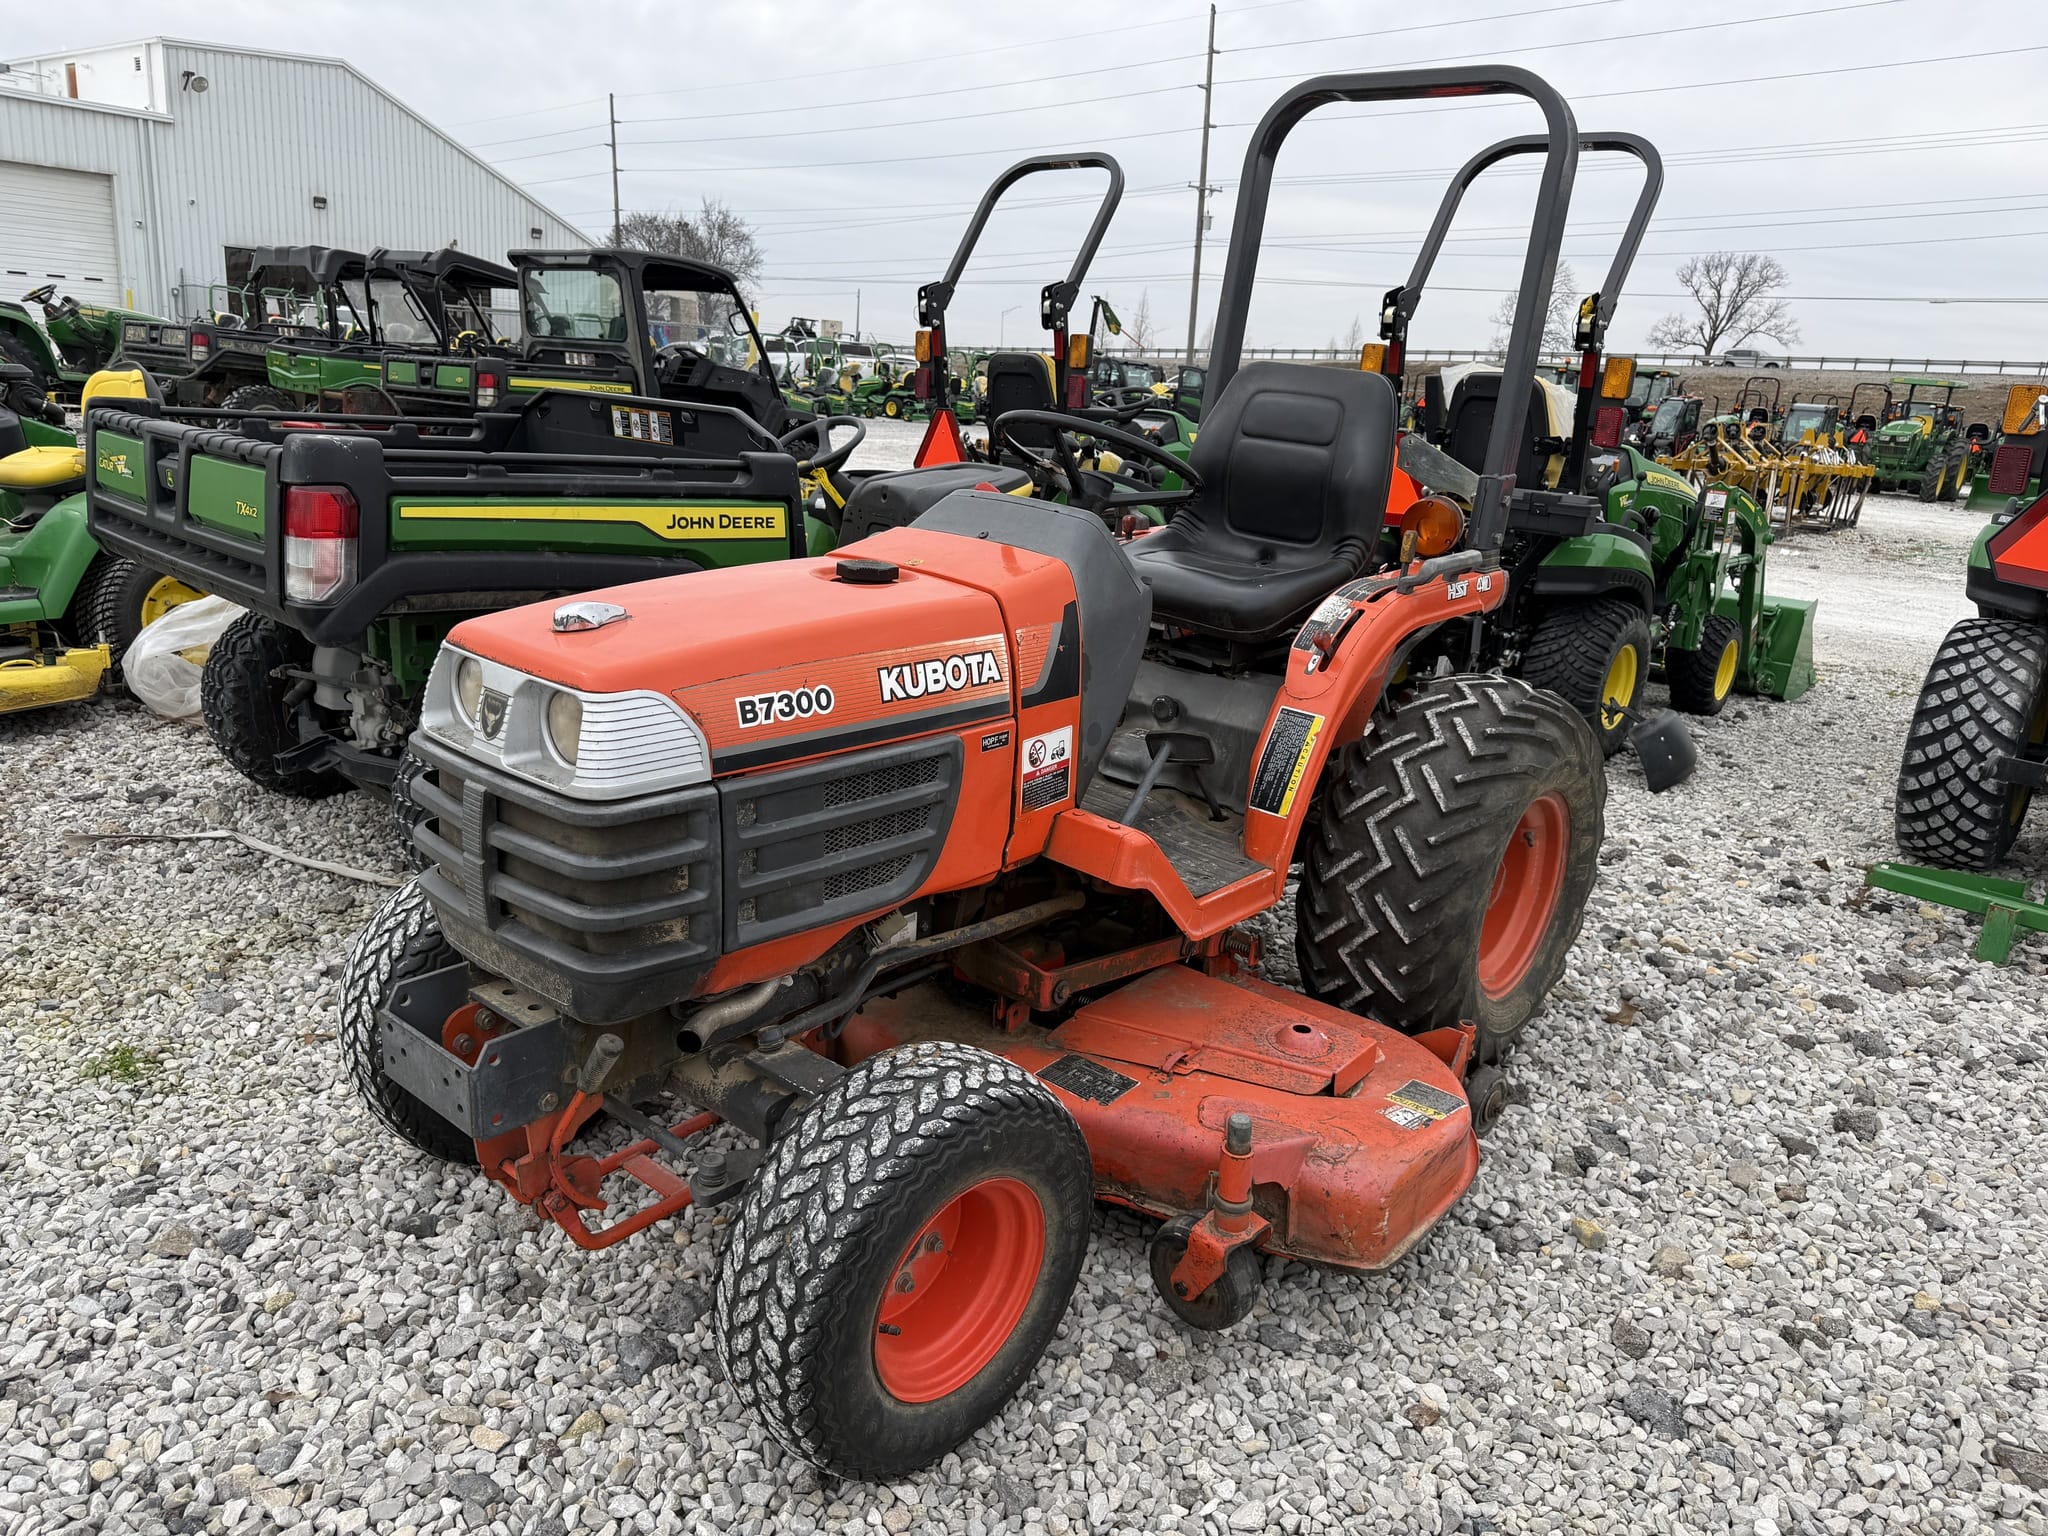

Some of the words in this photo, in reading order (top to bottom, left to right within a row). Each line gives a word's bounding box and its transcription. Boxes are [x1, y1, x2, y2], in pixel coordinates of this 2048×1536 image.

[666, 514, 715, 530] JOHN
[718, 514, 776, 529] DEERE
[1447, 580, 1469, 600] HST
[877, 650, 1003, 704] KUBOTA
[736, 685, 834, 728] B7300
[982, 735, 999, 748] HOPF
[1040, 763, 1058, 775] DANGER
[1288, 747, 1309, 792] CAUTION
